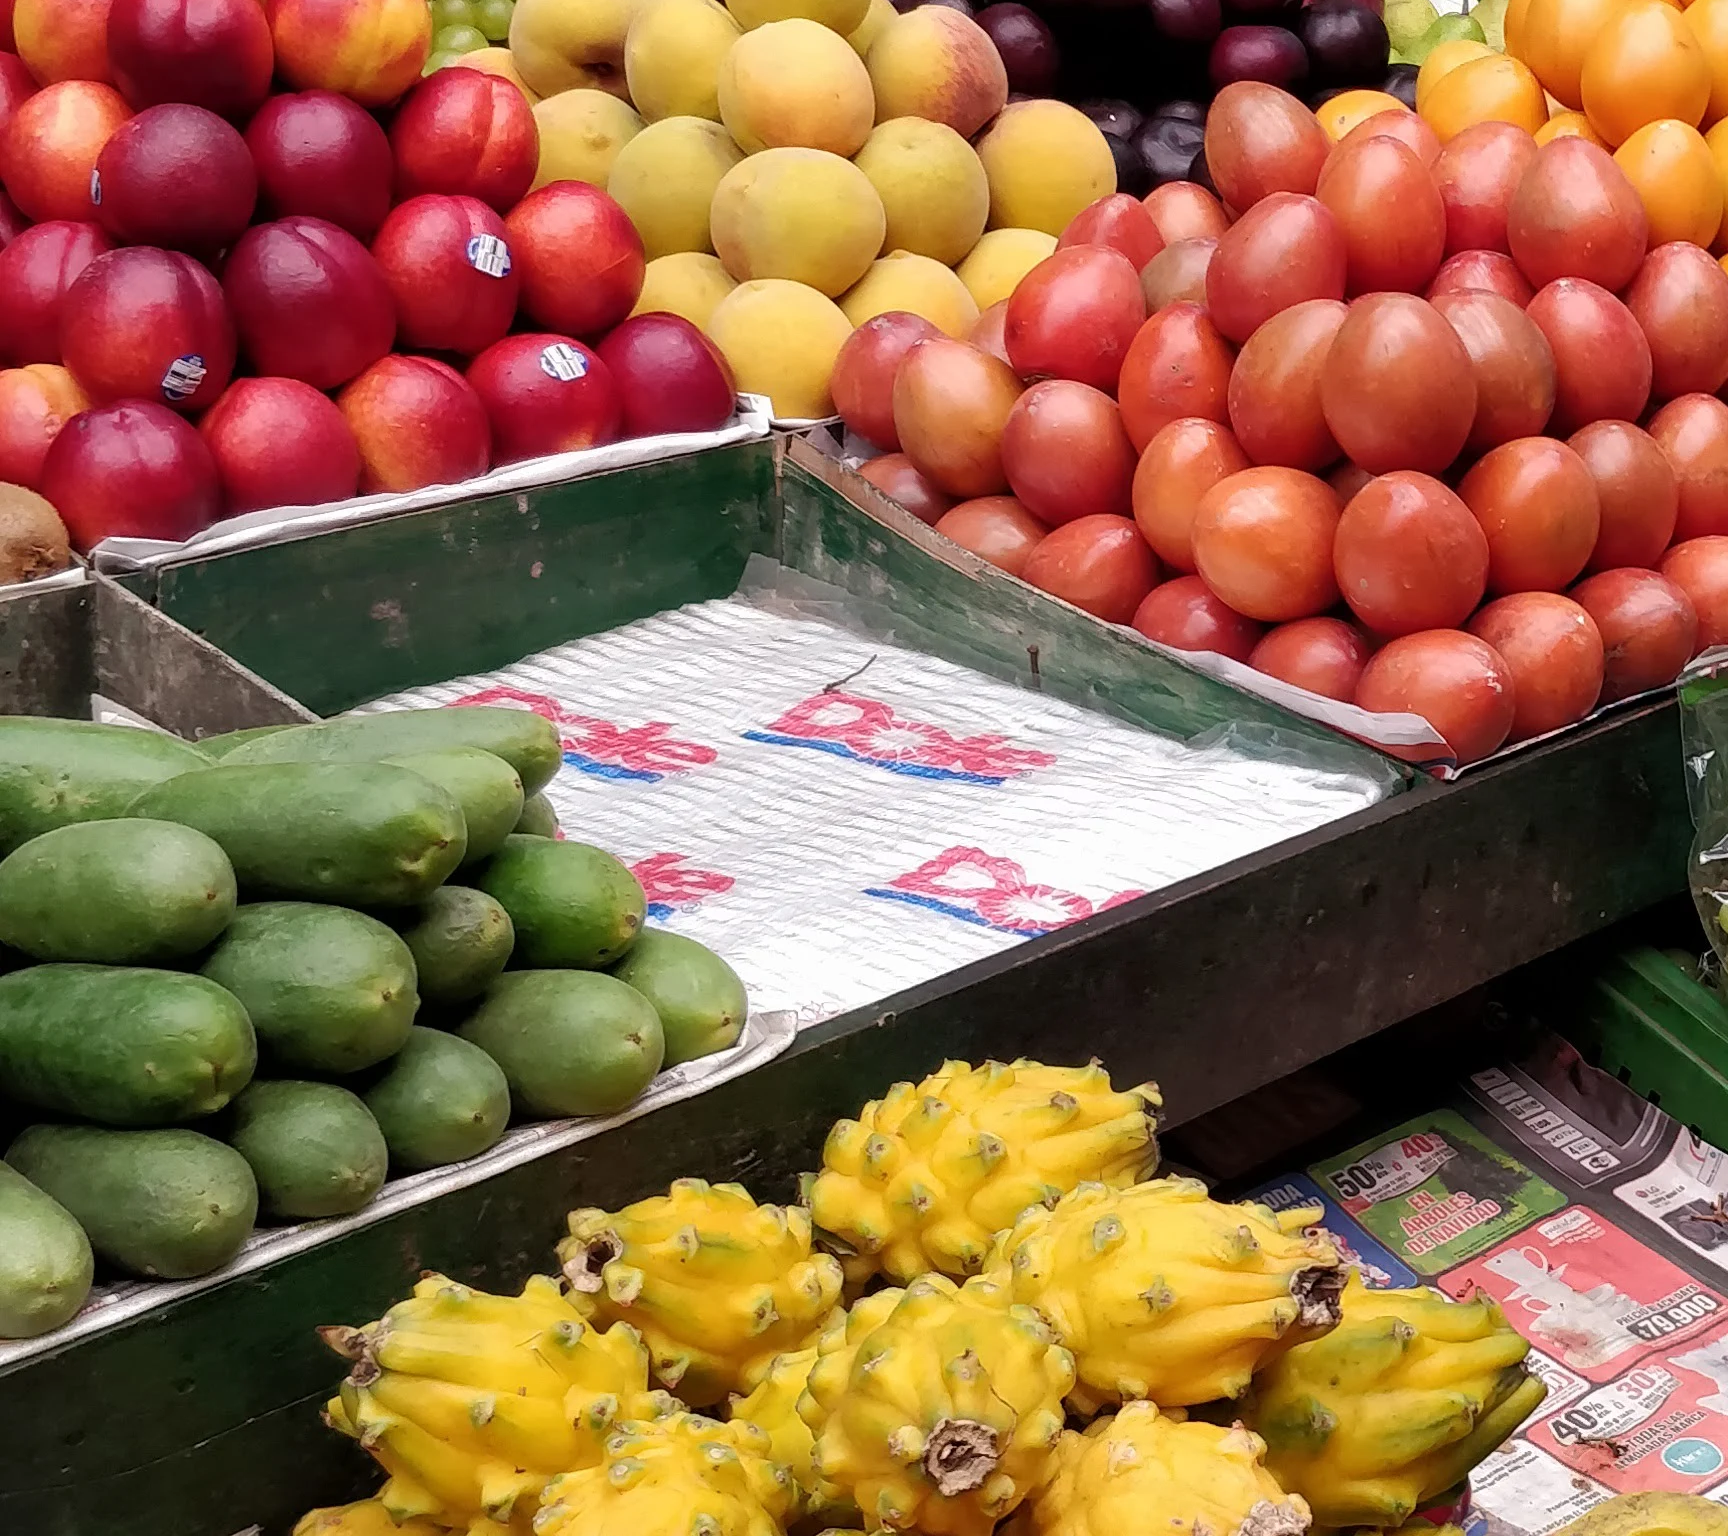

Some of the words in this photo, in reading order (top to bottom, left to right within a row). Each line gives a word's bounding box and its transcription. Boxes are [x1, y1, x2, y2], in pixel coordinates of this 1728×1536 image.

[1398, 1188, 1476, 1237] ÁRBOLES
[1407, 1187, 1435, 1213] EN
[1404, 1231, 1437, 1257] DE
[1428, 1197, 1503, 1245] NAVIDAD
[1669, 1407, 1708, 1436] MARCA
